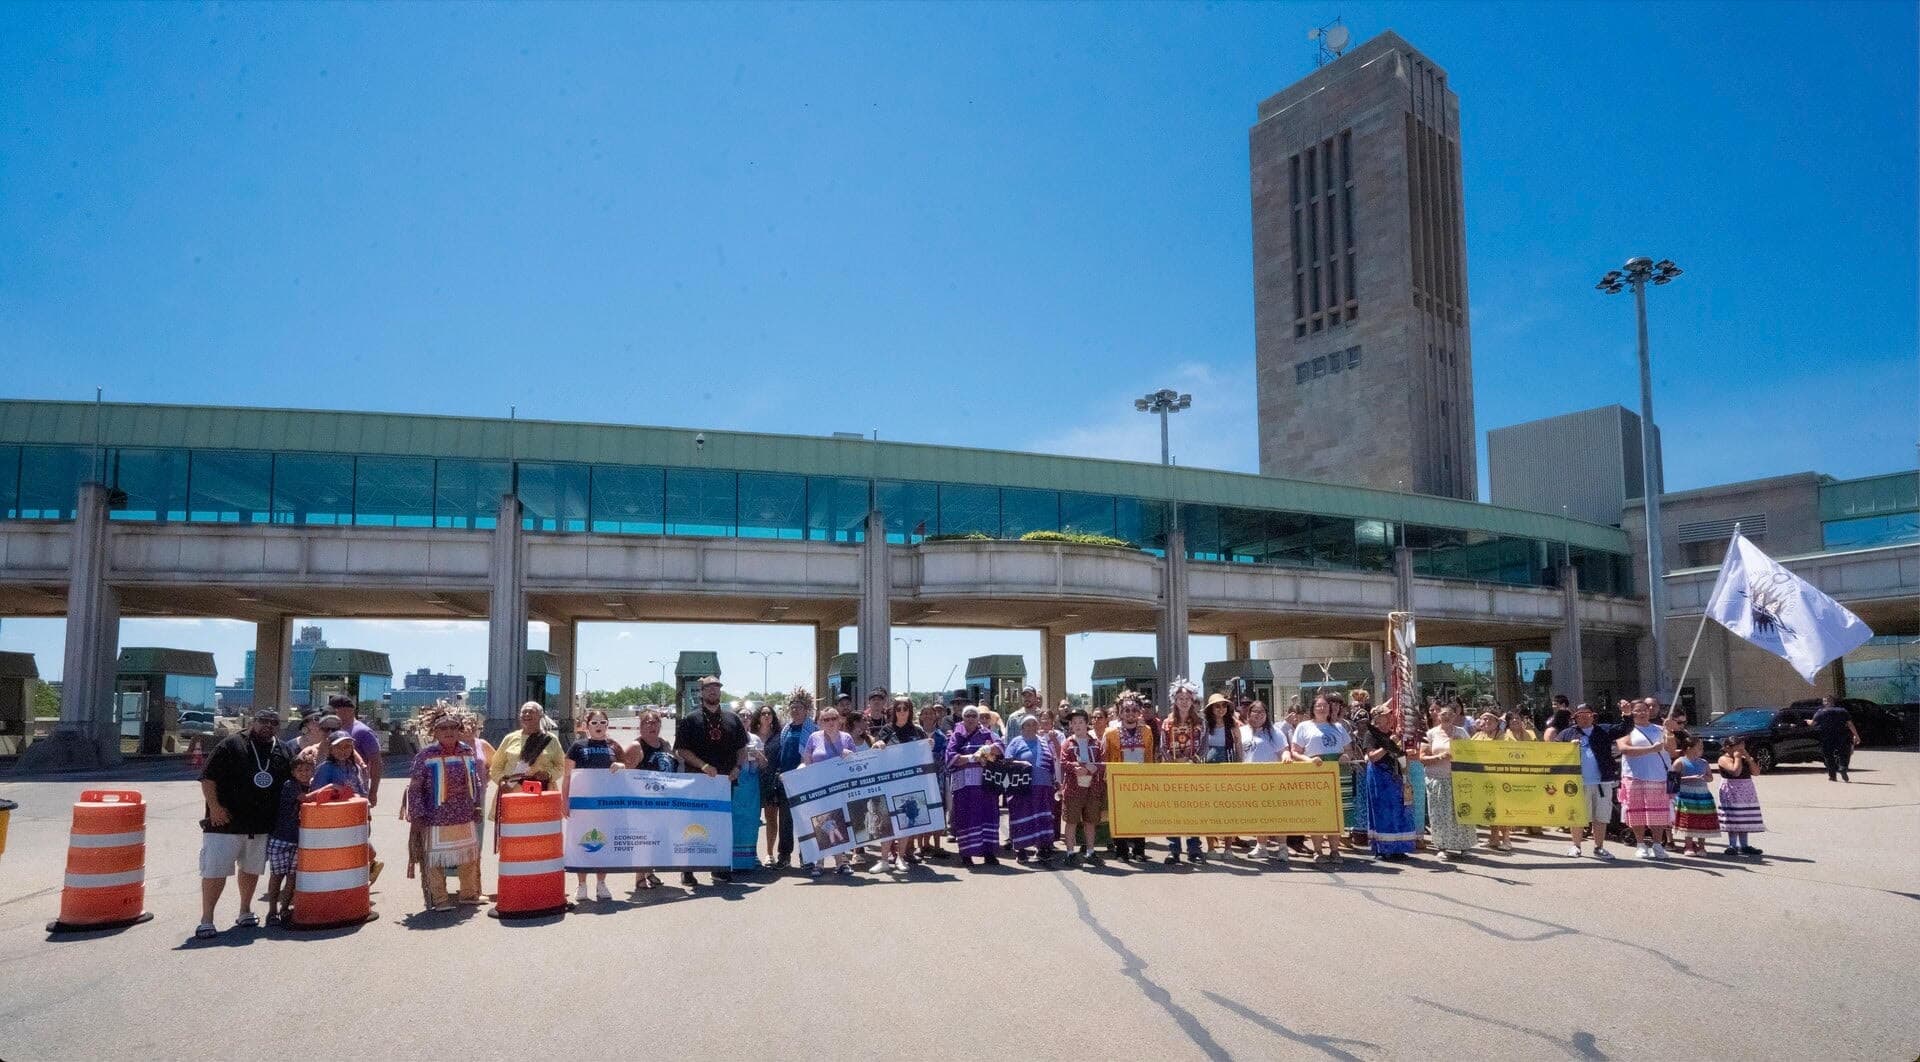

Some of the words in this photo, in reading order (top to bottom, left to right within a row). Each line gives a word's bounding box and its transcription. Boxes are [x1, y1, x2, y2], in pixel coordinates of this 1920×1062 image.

[1120, 783, 1159, 792] INDIAN
[1163, 783, 1211, 792] DEFENSE
[1215, 782, 1257, 791] LEAGUE
[1261, 782, 1275, 791] OF
[1279, 781, 1330, 790] AMERICA
[597, 799, 625, 807] Thank
[628, 800, 643, 808] you
[1132, 800, 1171, 809] ANNUAL
[1174, 800, 1210, 808] BORDER
[1213, 800, 1258, 808] CROSSING
[1261, 799, 1321, 808] CELEBRATION
